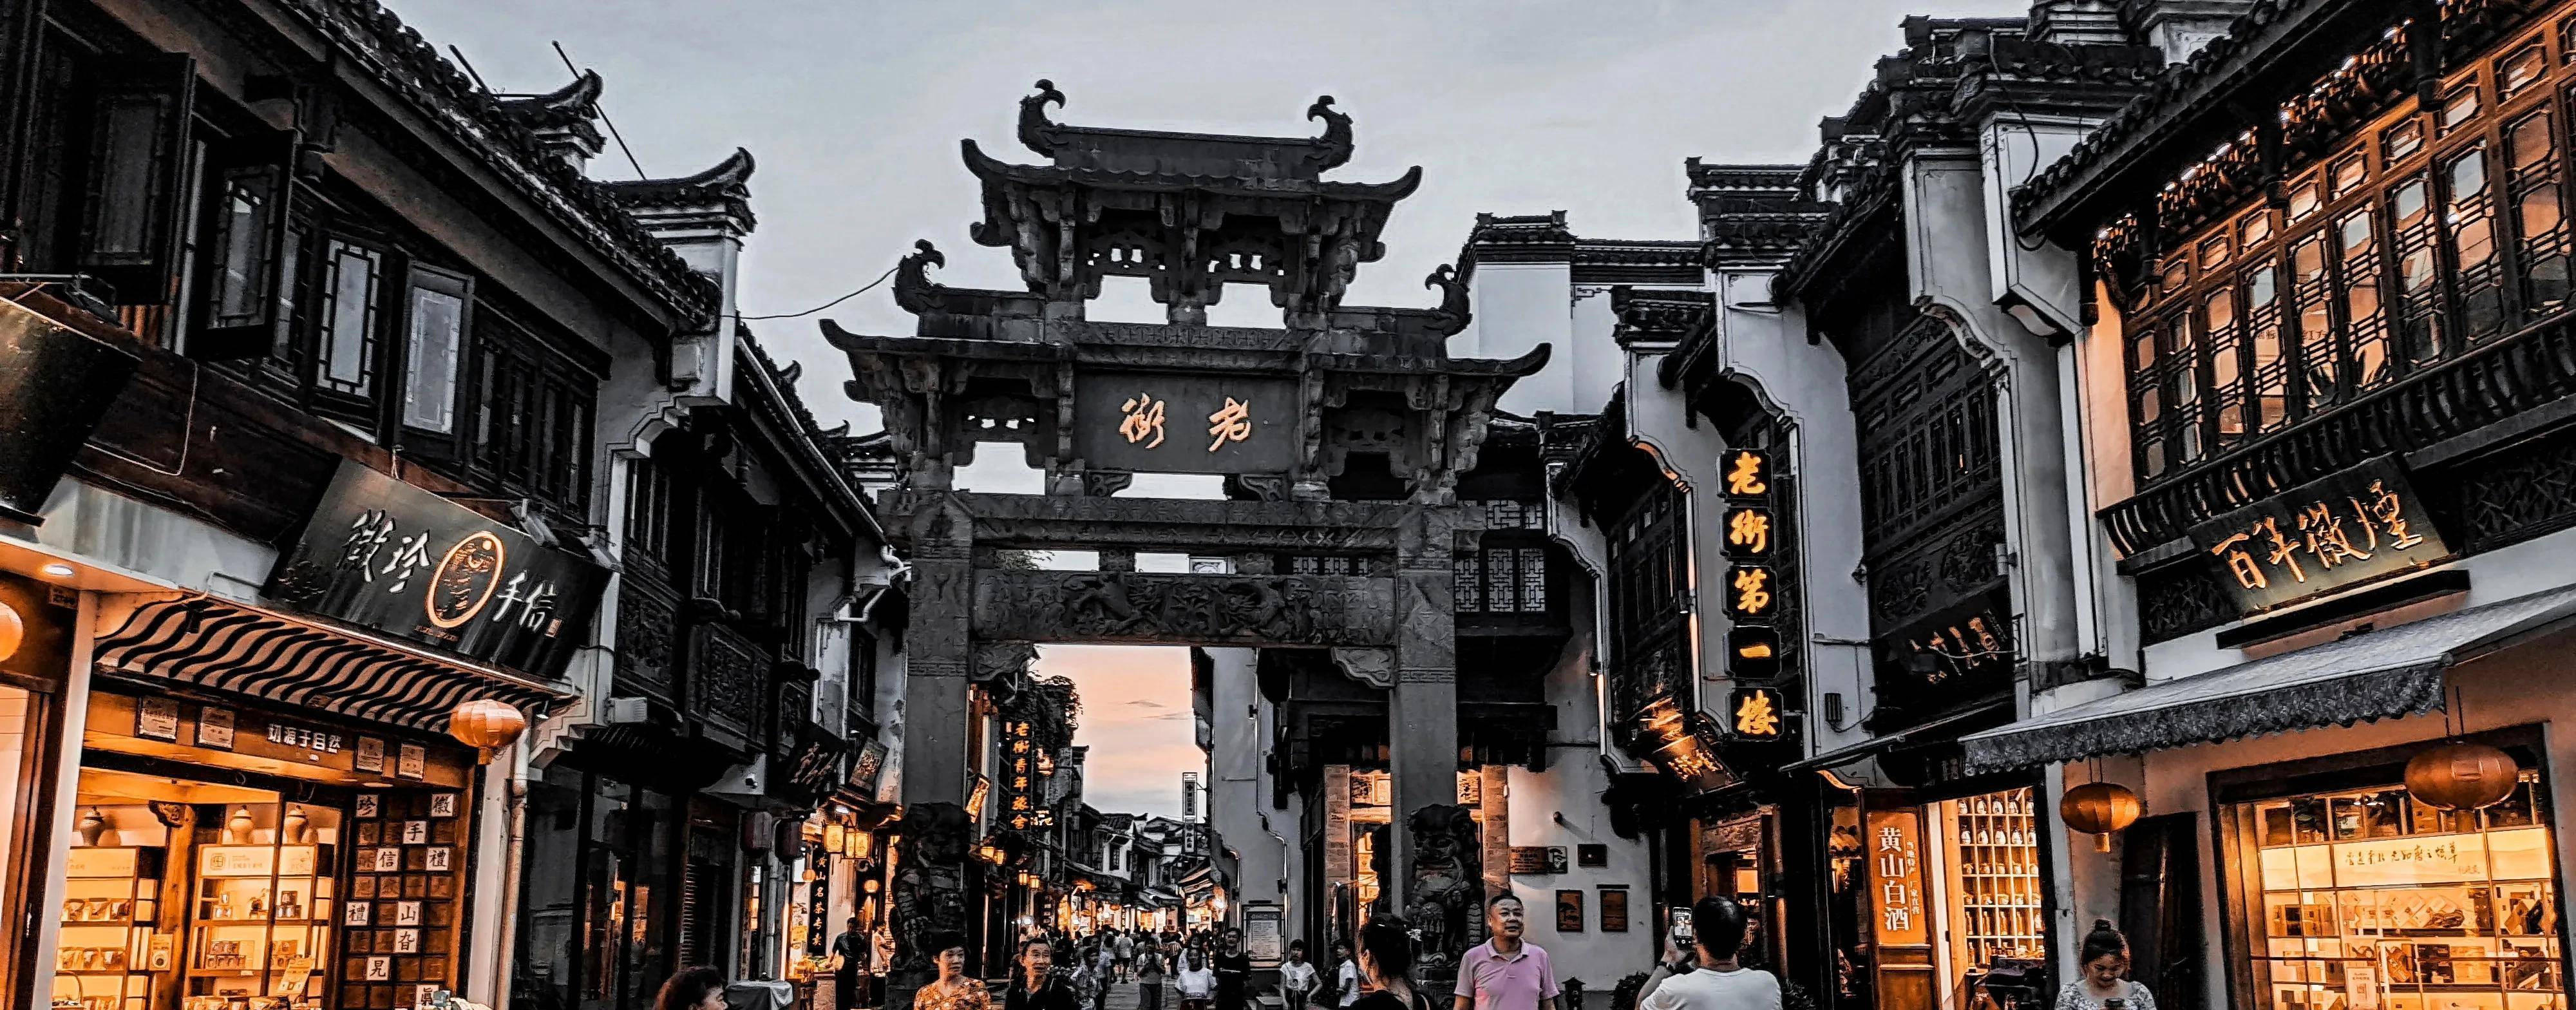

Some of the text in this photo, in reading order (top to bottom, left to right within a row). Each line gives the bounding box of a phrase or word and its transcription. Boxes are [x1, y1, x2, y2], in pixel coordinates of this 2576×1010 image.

[493, 569, 558, 633] 手信
[1728, 452, 1779, 736] 老街第一楼
[379, 850, 397, 868] 信
[406, 823, 424, 841] 手
[813, 857, 828, 947] 黄山名茶专卖
[1877, 826, 1909, 931] 黄山白酒
[401, 905, 417, 921] 山
